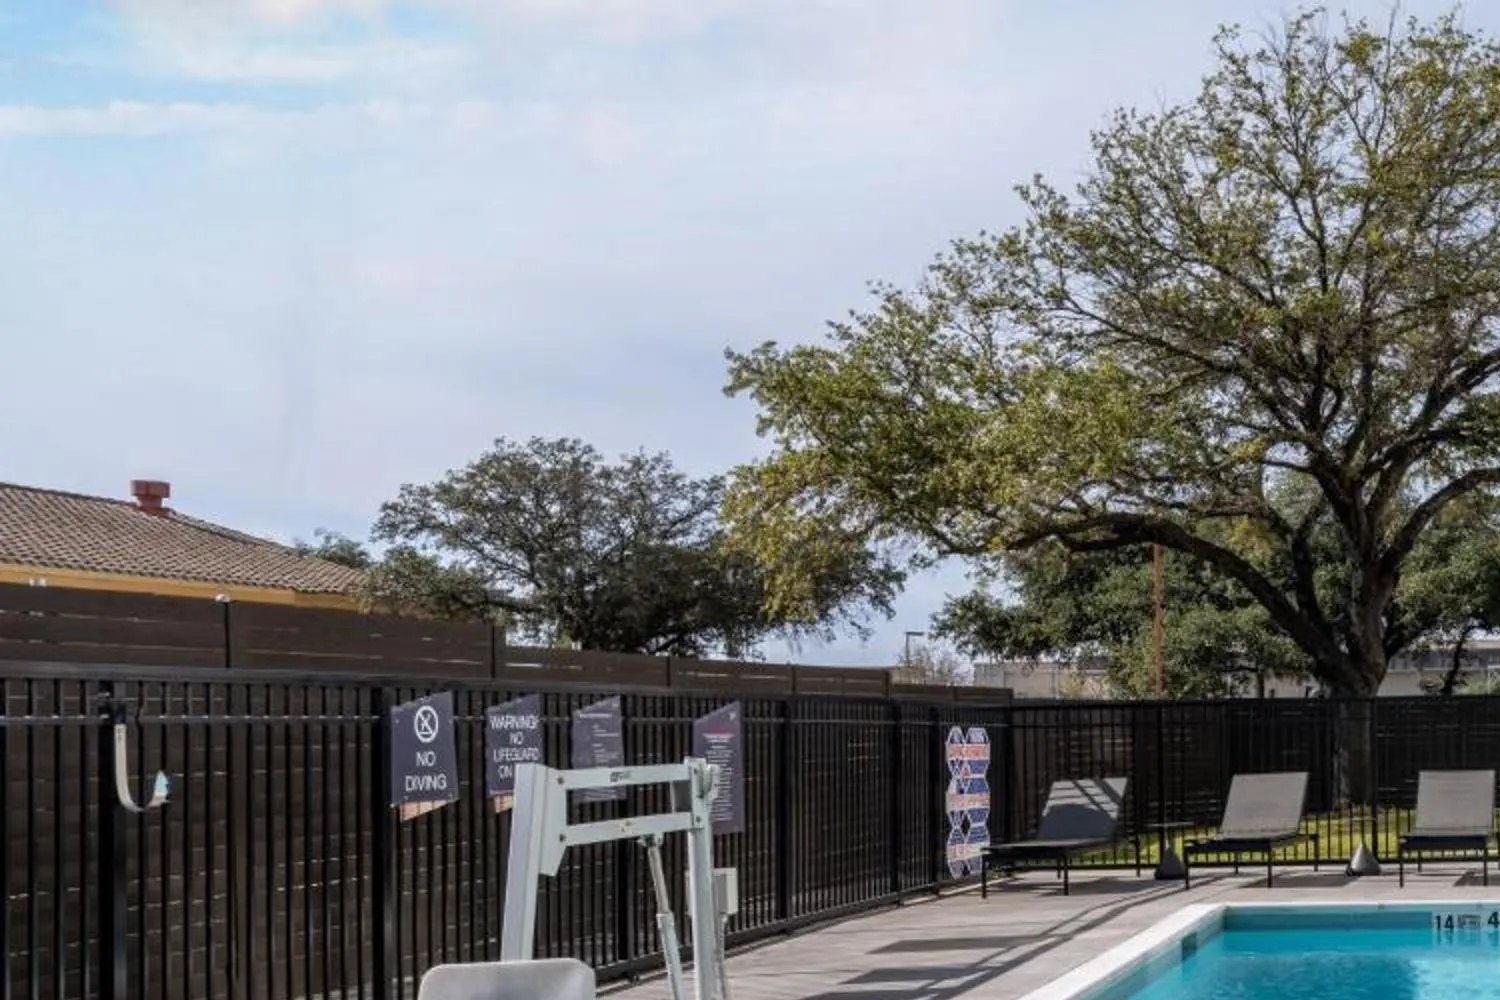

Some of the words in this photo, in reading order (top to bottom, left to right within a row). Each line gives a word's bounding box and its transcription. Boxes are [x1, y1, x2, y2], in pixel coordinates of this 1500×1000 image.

[509, 732, 525, 745] NO
[416, 751, 436, 767] NO
[493, 747, 540, 763] LIFEGUARD
[405, 774, 447, 791] DIVING
[1487, 911, 1500, 928] 4
